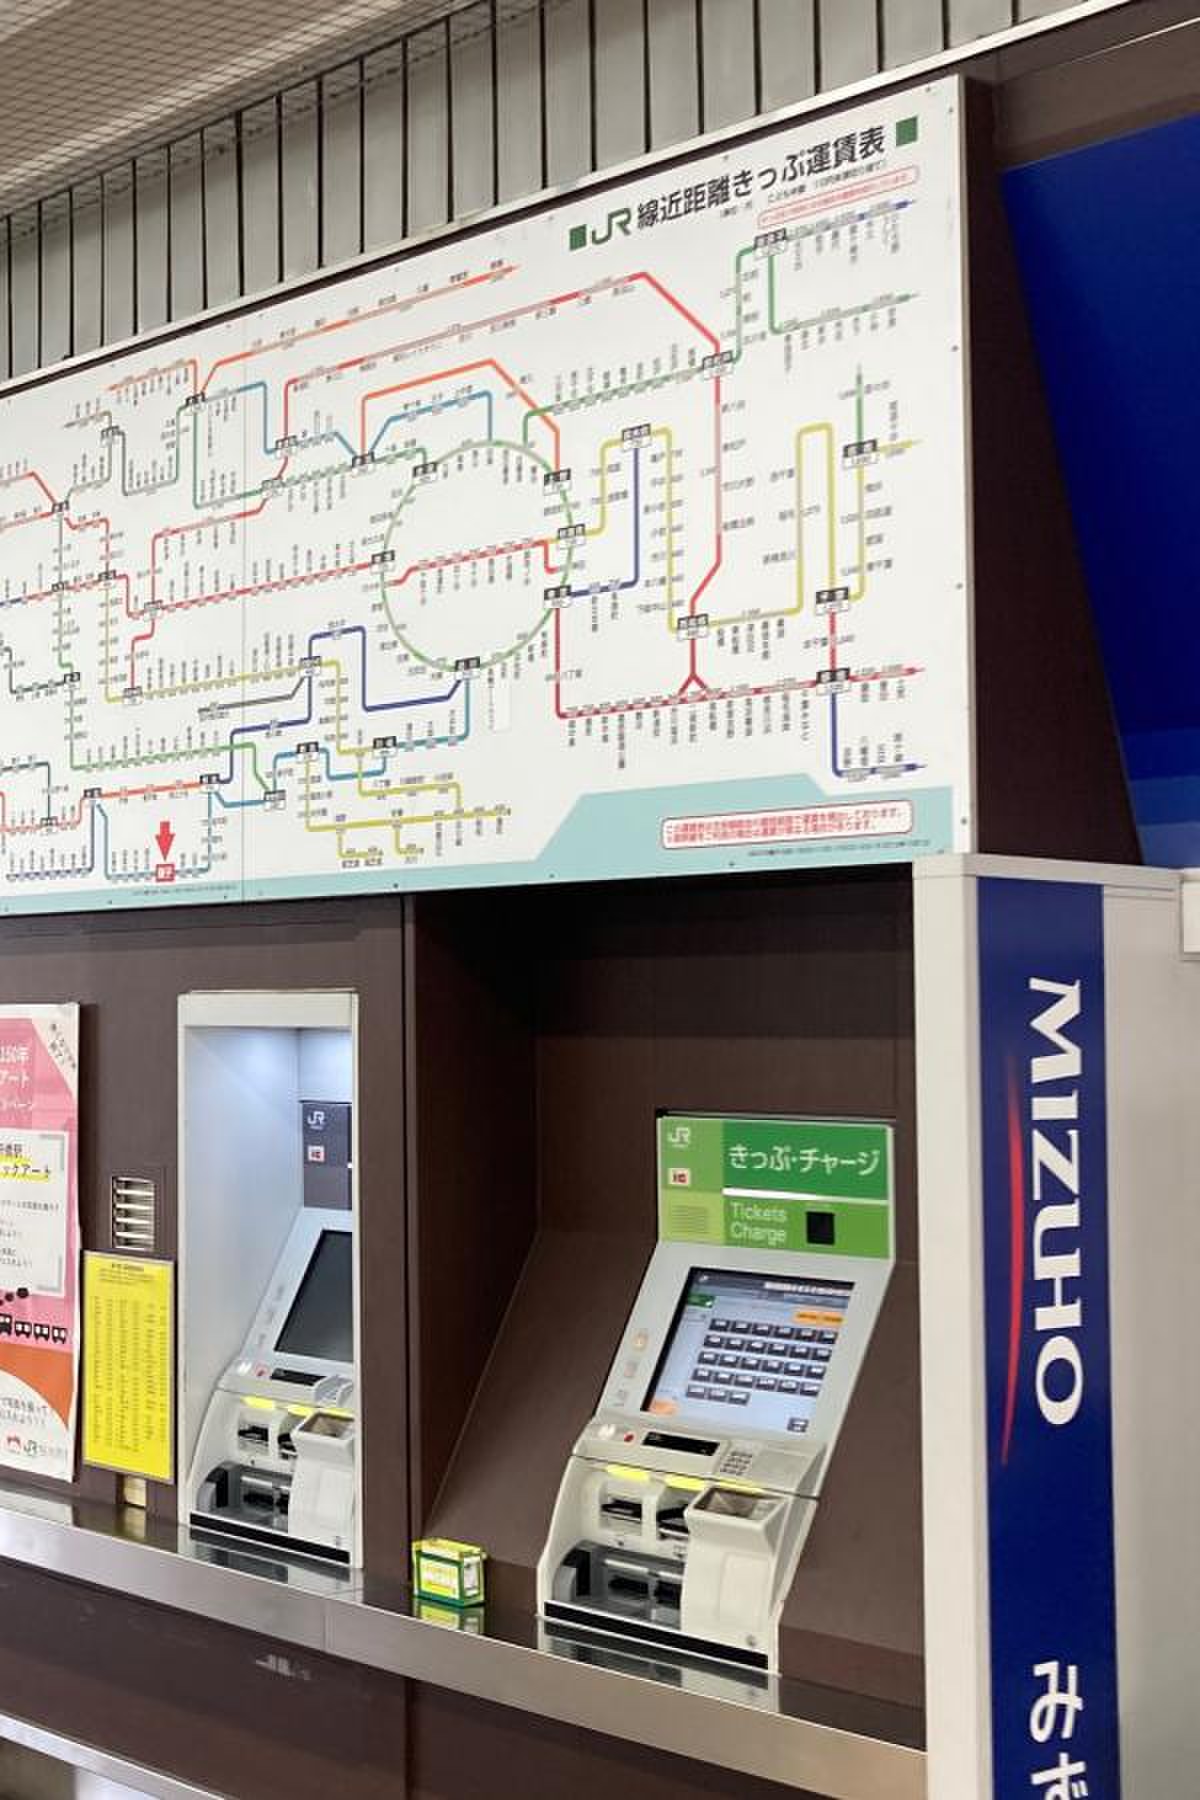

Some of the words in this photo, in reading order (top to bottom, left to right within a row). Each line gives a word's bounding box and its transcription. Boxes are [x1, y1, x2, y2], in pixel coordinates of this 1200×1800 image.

[667, 1127, 691, 1142] JR
[729, 1144, 880, 1176] きっぷ・チャージ
[730, 1202, 787, 1222] Tickets
[1029, 977, 1084, 1425] MIZUHO
[730, 1221, 787, 1246] Charge
